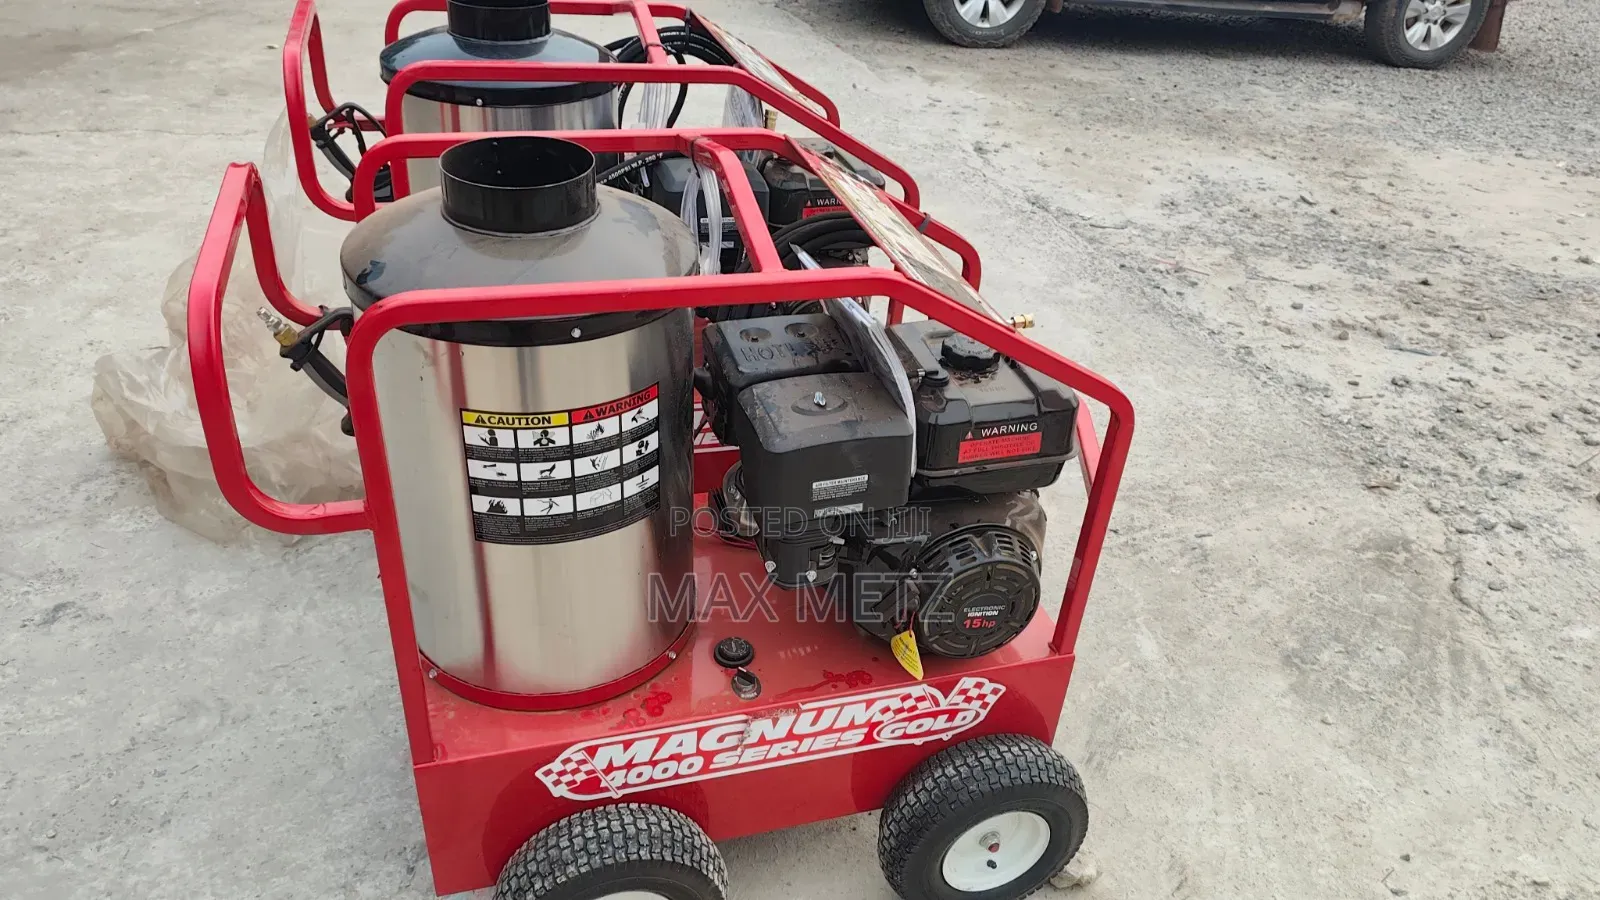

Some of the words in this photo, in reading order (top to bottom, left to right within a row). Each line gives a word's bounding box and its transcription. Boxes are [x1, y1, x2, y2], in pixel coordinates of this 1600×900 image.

[594, 390, 651, 417] WARNING
[487, 415, 552, 426] CAUTION
[981, 422, 1038, 437] WARNING
[591, 696, 898, 770] MAGNUM
[881, 709, 977, 740] GOLD
[601, 756, 704, 788] 4000
[709, 727, 869, 769] SERIES
